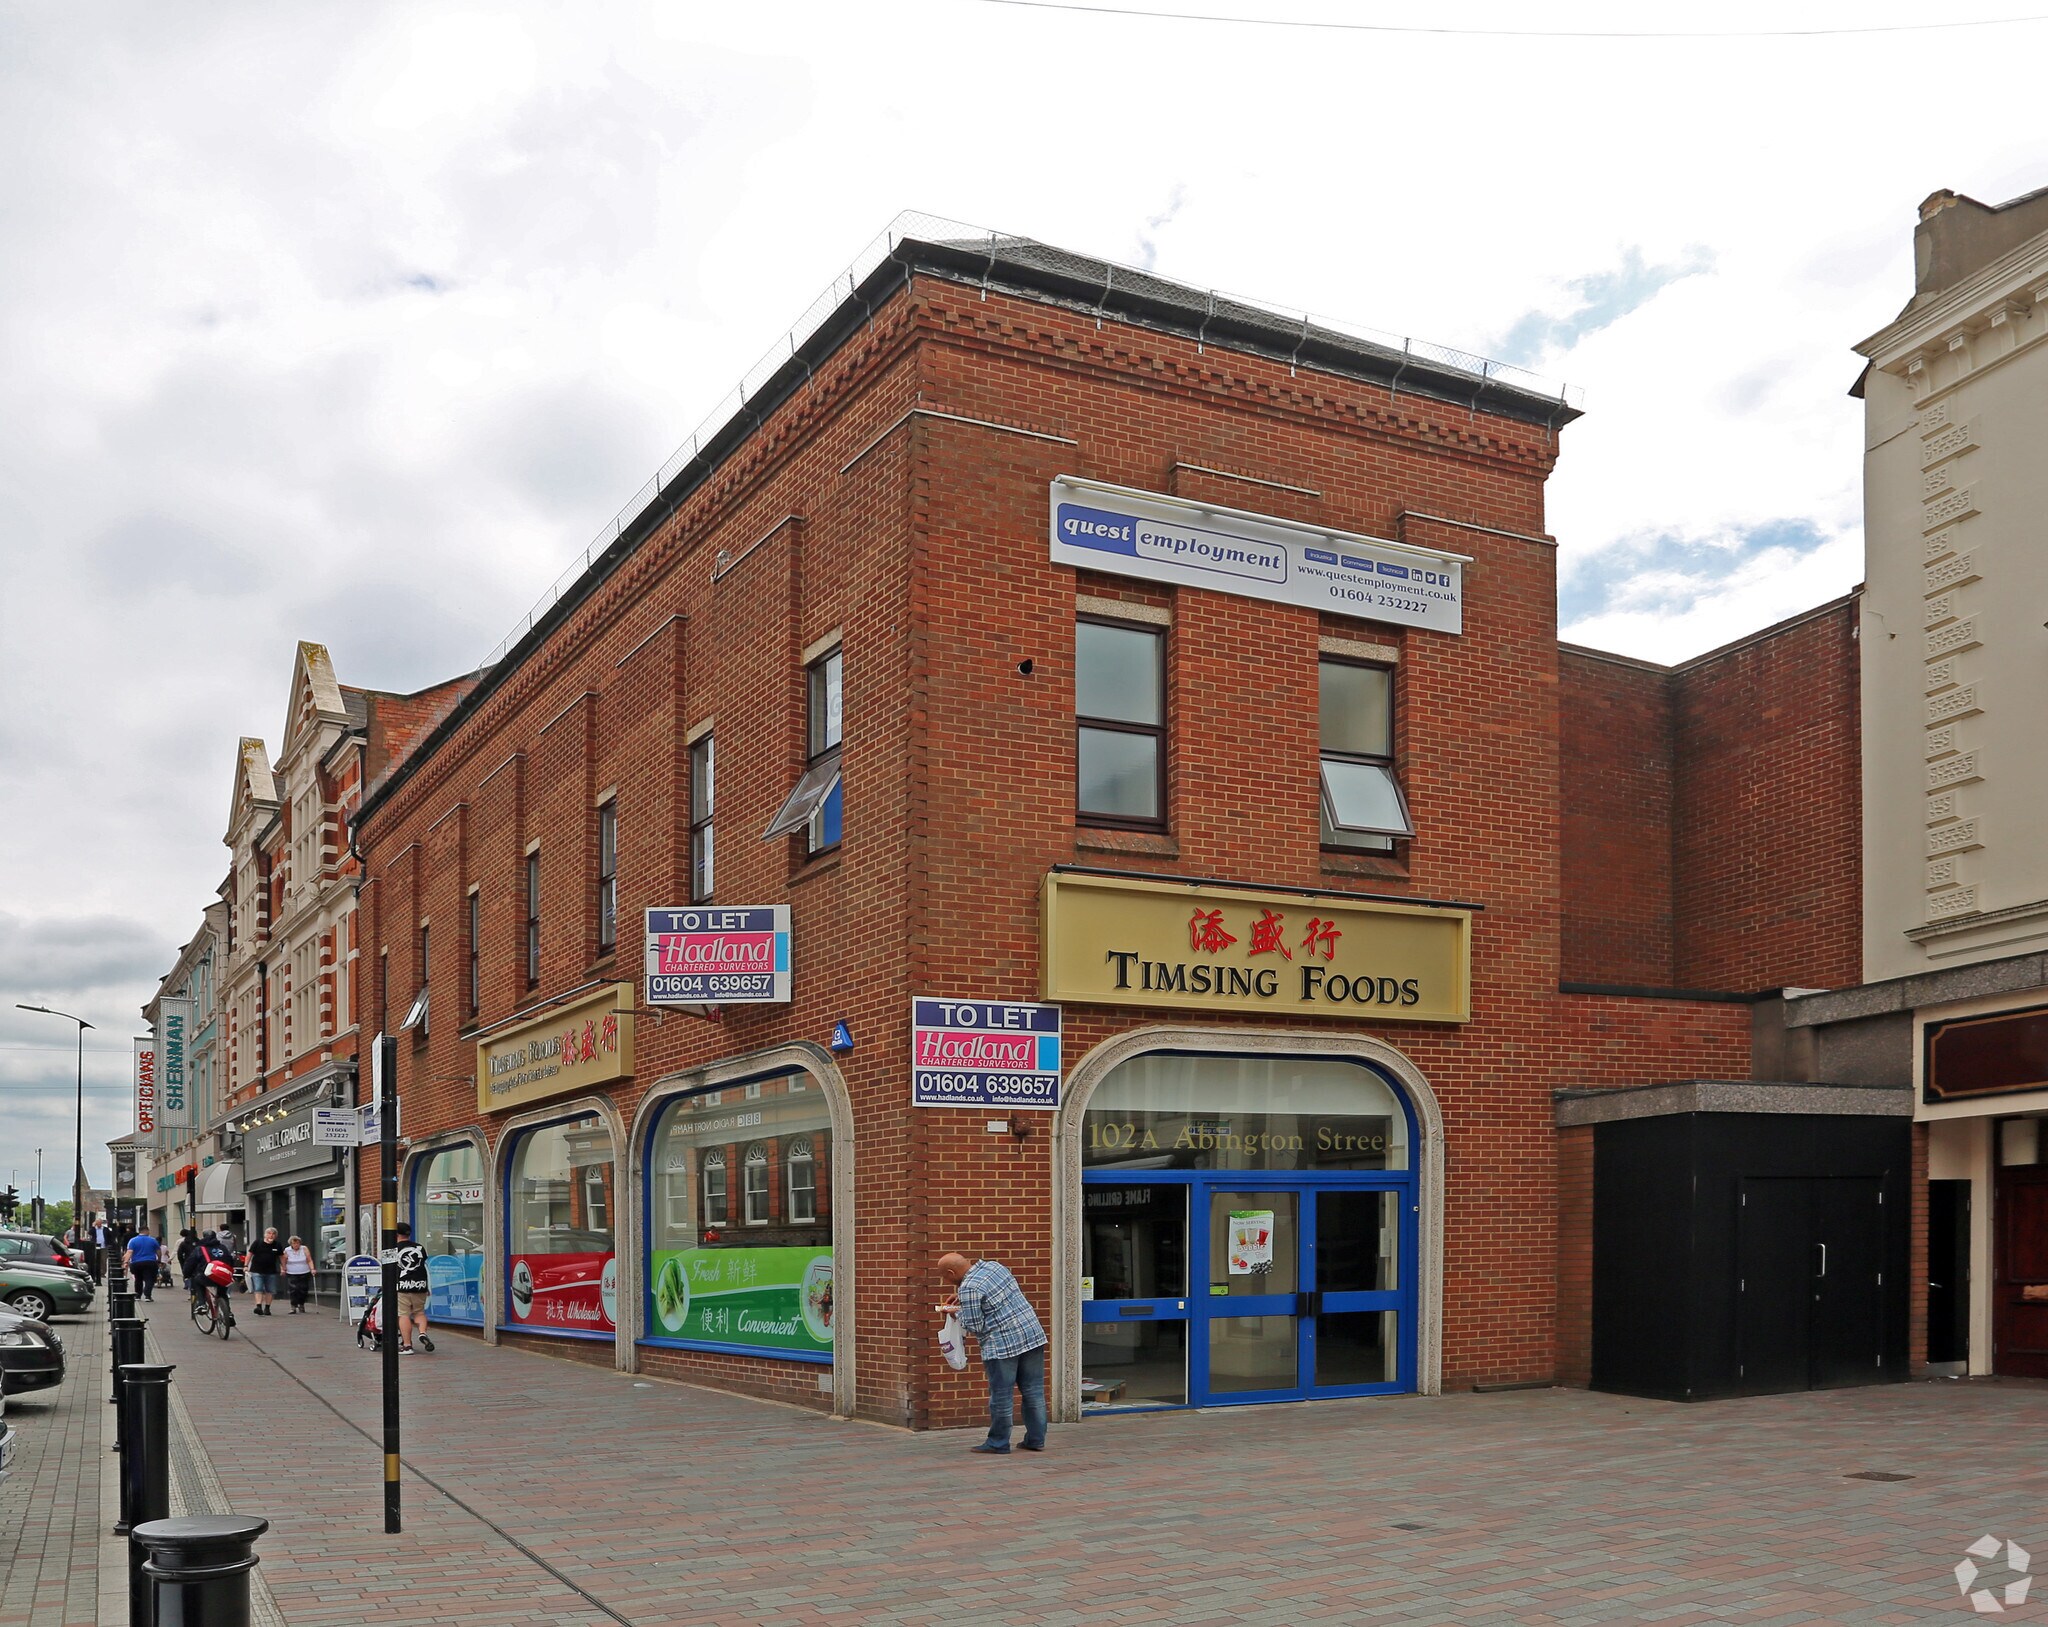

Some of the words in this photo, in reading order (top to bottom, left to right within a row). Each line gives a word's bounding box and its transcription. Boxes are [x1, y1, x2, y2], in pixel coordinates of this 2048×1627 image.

[1063, 517, 1131, 541] quest
[1140, 532, 1280, 569] employment
[1310, 552, 1333, 562] Industrial
[1342, 558, 1373, 569] Commercial
[1382, 565, 1404, 576] Technical
[1297, 565, 1457, 602] www.questemployment.co.uk
[1329, 585, 1374, 604] 01604
[1377, 594, 1428, 613] 232227
[668, 912, 701, 930] TO
[707, 912, 751, 929] LET
[1188, 906, 1342, 961] 添盛行
[665, 936, 772, 963] Hadland
[665, 962, 715, 972] CHARTERED
[718, 962, 769, 971] SURVEYORS
[1106, 950, 1279, 998] TIMSING
[1300, 965, 1420, 1006] FOODS
[652, 976, 703, 992] 01604
[708, 975, 771, 991] 639657
[938, 1003, 978, 1027] TO
[986, 1006, 1037, 1029] LET
[921, 1032, 1033, 1061] Hadland
[921, 1057, 974, 1067] CHARTERED
[977, 1059, 1029, 1069] SURVEYORS
[139, 1050, 155, 1133] OPTICIANS
[920, 1073, 979, 1093] 01604
[985, 1075, 1055, 1095] 639657
[919, 1094, 985, 1102] www.hadlands.co.uk
[992, 1095, 1054, 1104] info@hadlands.co.uk
[1089, 1122, 1160, 1149] 102A
[1173, 1124, 1304, 1156] Abington
[691, 1259, 721, 1282] Fresh
[567, 1301, 601, 1321] Wholesale
[700, 1306, 730, 1334] 便利
[737, 1309, 803, 1336] Convenient
